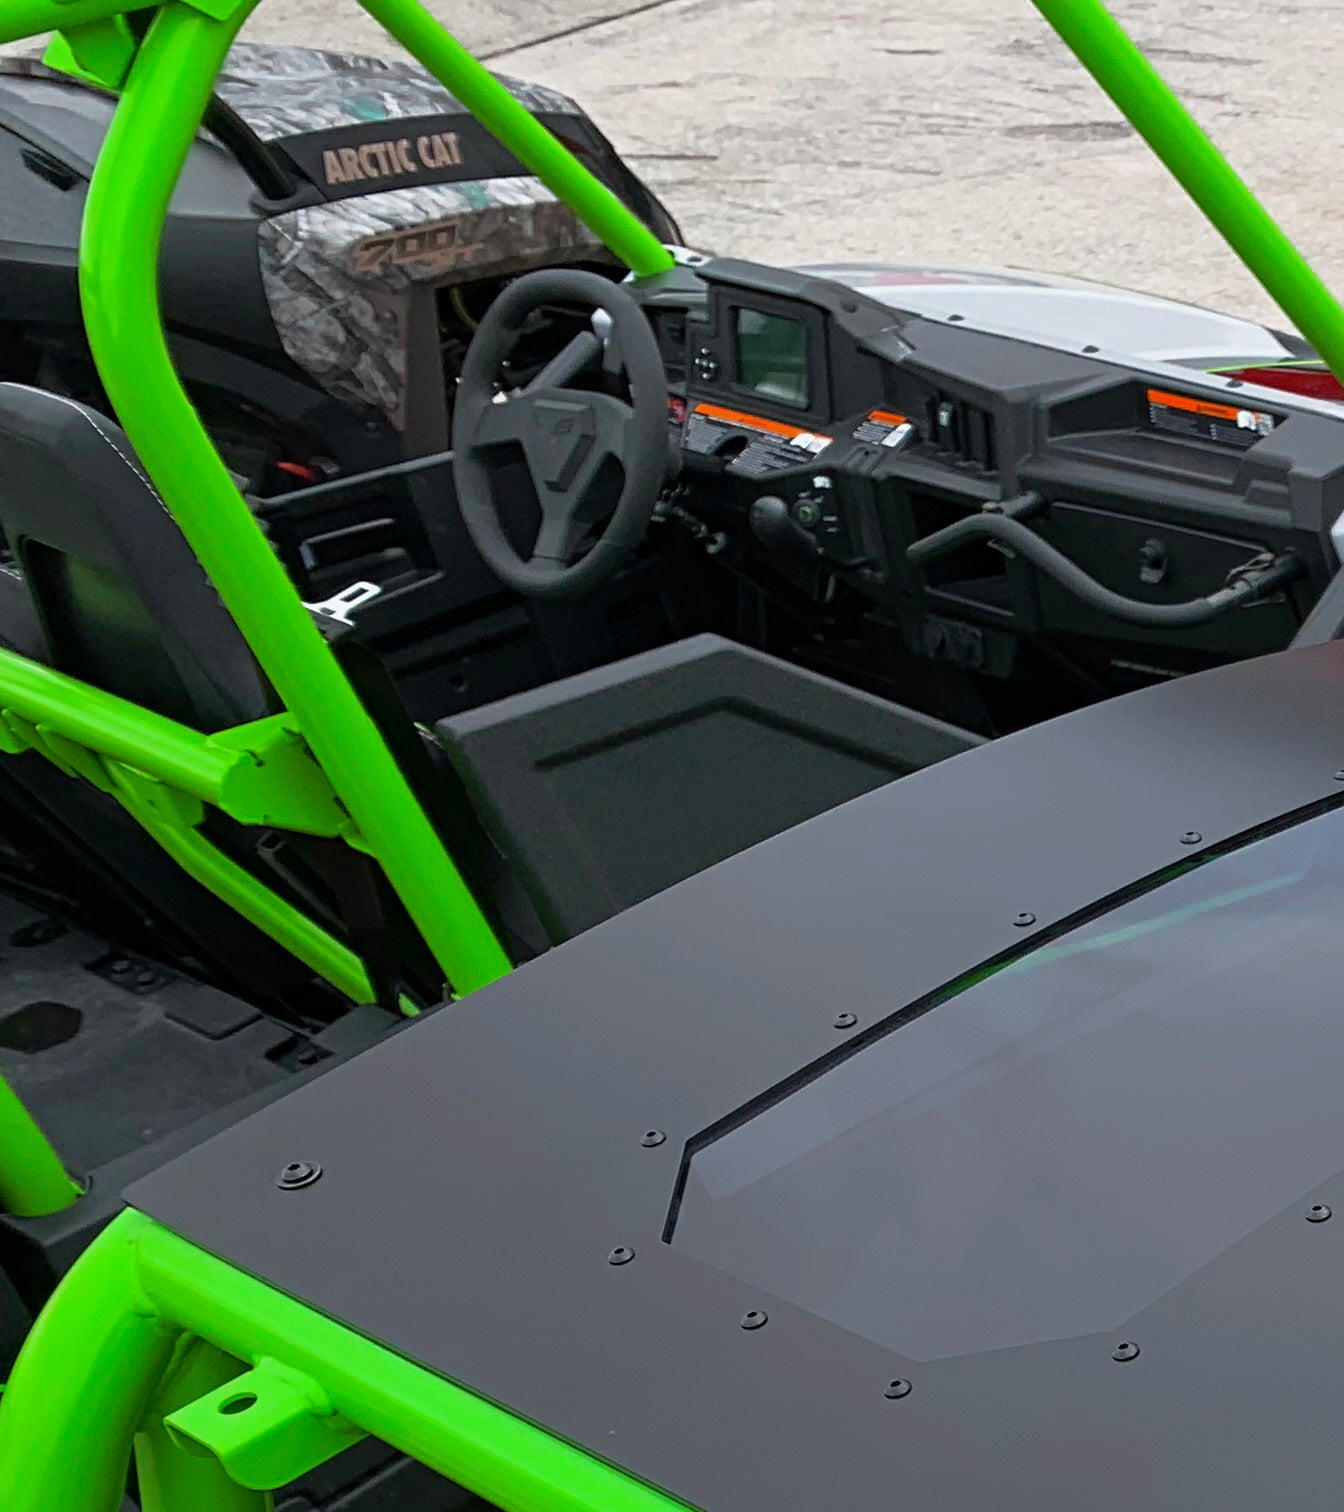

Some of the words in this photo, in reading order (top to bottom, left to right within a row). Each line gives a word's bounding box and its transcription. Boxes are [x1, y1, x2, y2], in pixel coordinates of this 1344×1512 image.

[322, 138, 418, 185] ARCTIC
[417, 132, 462, 170] CAT
[353, 219, 462, 276] 700
